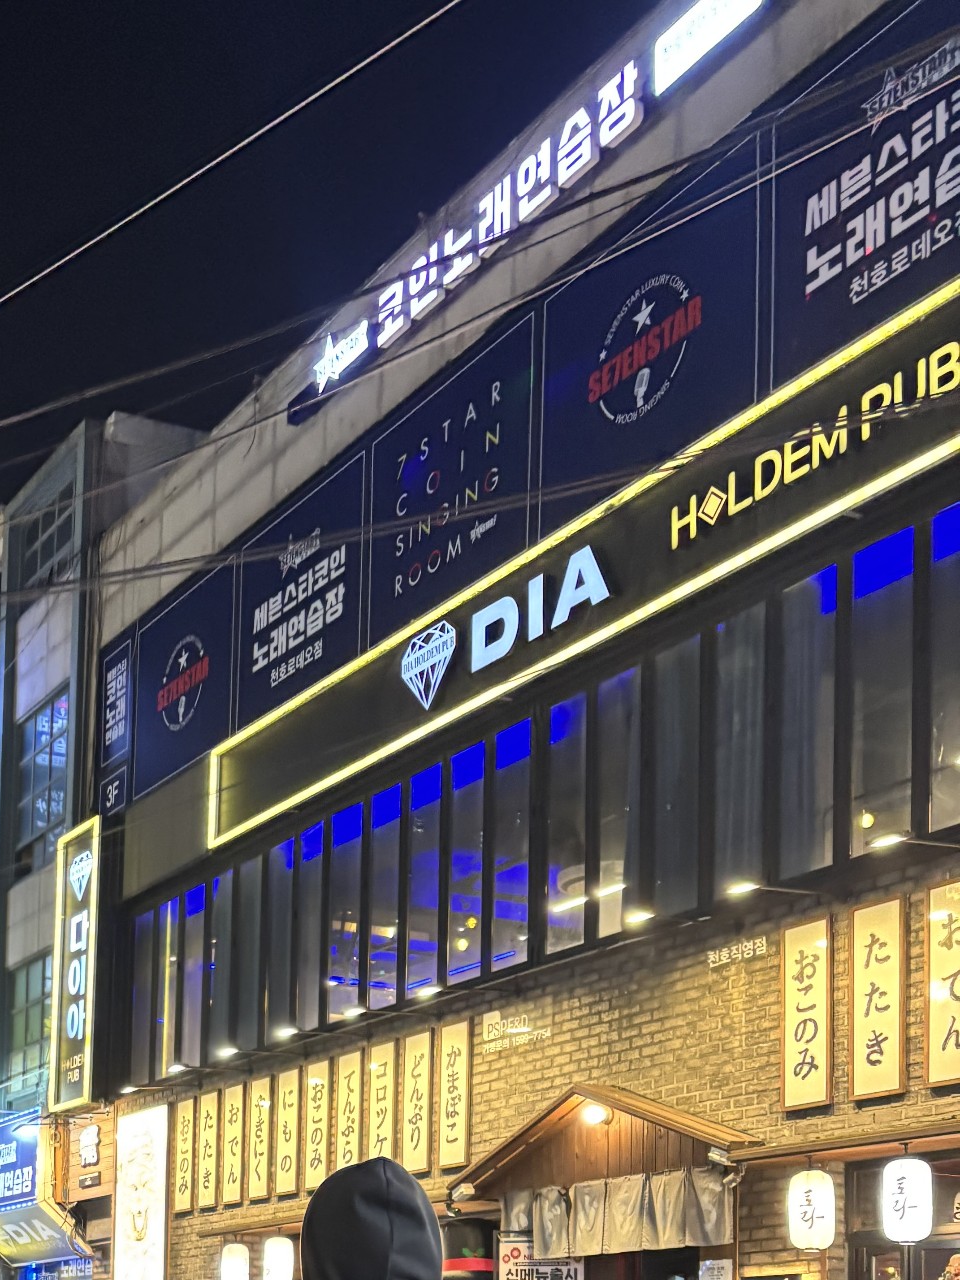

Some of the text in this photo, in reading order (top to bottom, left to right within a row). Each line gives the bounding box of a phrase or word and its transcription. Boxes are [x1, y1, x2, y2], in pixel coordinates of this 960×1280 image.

[377, 59, 639, 348] 코인노래연습장
[849, 211, 960, 304] 천호로데오
[861, 341, 960, 441] PUB
[253, 544, 346, 635] 세븐스타코인
[394, 534, 462, 598] ROOM
[470, 544, 610, 674] DIA
[252, 584, 345, 673] 노래연습장
[105, 694, 126, 729] 노래
[106, 673, 126, 706] 코인
[106, 780, 120, 809] 3F
[66, 909, 90, 1040] 다이아
[792, 949, 820, 1080] おこのみ
[863, 933, 891, 1067] たたき
[67, 1069, 80, 1083] PUB
[341, 1070, 356, 1164] てんぷら
[408, 1053, 424, 1151] どんぶり
[445, 1045, 461, 1144] かまぼこ
[178, 1115, 191, 1196] おこのみ
[202, 1110, 214, 1190] たたき
[227, 1104, 240, 1184] おでん
[253, 1094, 265, 1182] やきにく
[280, 1089, 294, 1173] にもの
[310, 1082, 325, 1171] おこのみ
